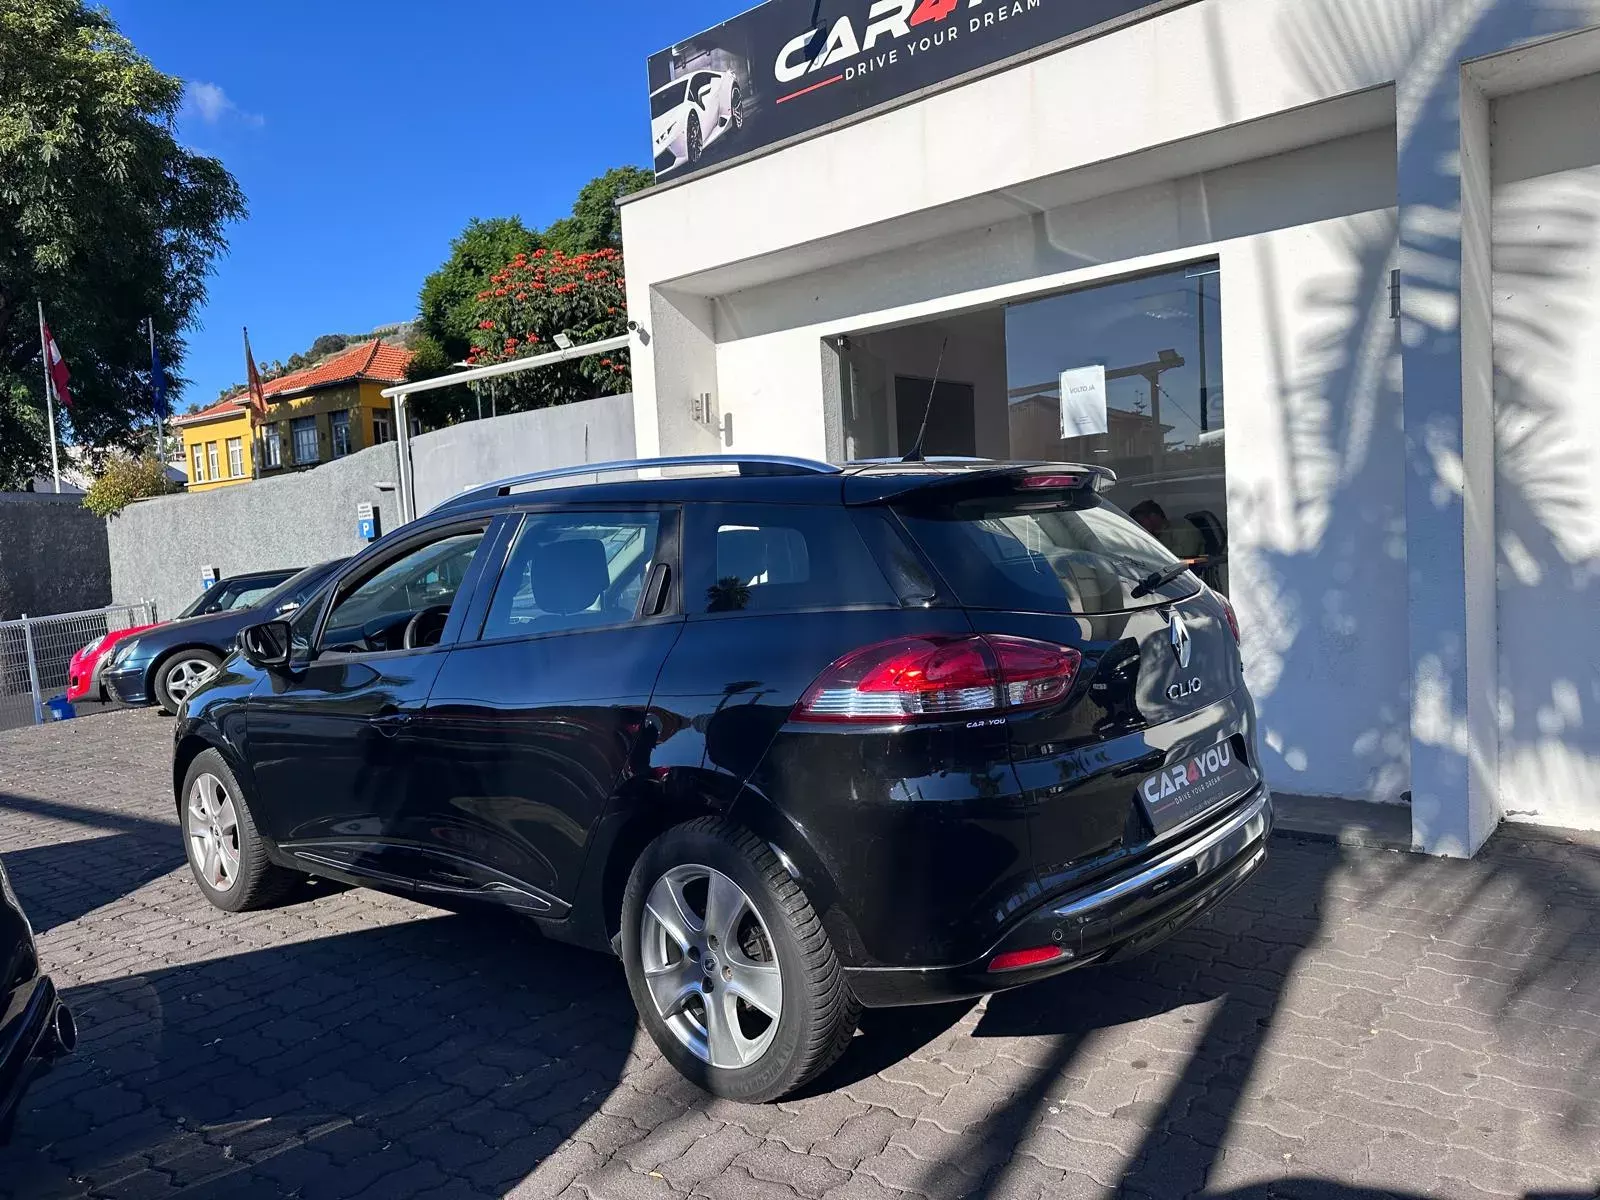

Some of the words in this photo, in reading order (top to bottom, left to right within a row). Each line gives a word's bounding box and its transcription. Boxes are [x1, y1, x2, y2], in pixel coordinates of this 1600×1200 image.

[775, 0, 983, 82] CAR4
[845, 50, 897, 80] DRIVE
[907, 27, 958, 56] YOUR
[969, 0, 1040, 32] DREAM
[1167, 677, 1201, 700] CLIO
[1144, 743, 1230, 803] CAR4YOU
[1174, 792, 1194, 805] DRIVE
[1192, 783, 1206, 795] YOUR
[1206, 777, 1221, 789] DREAM
